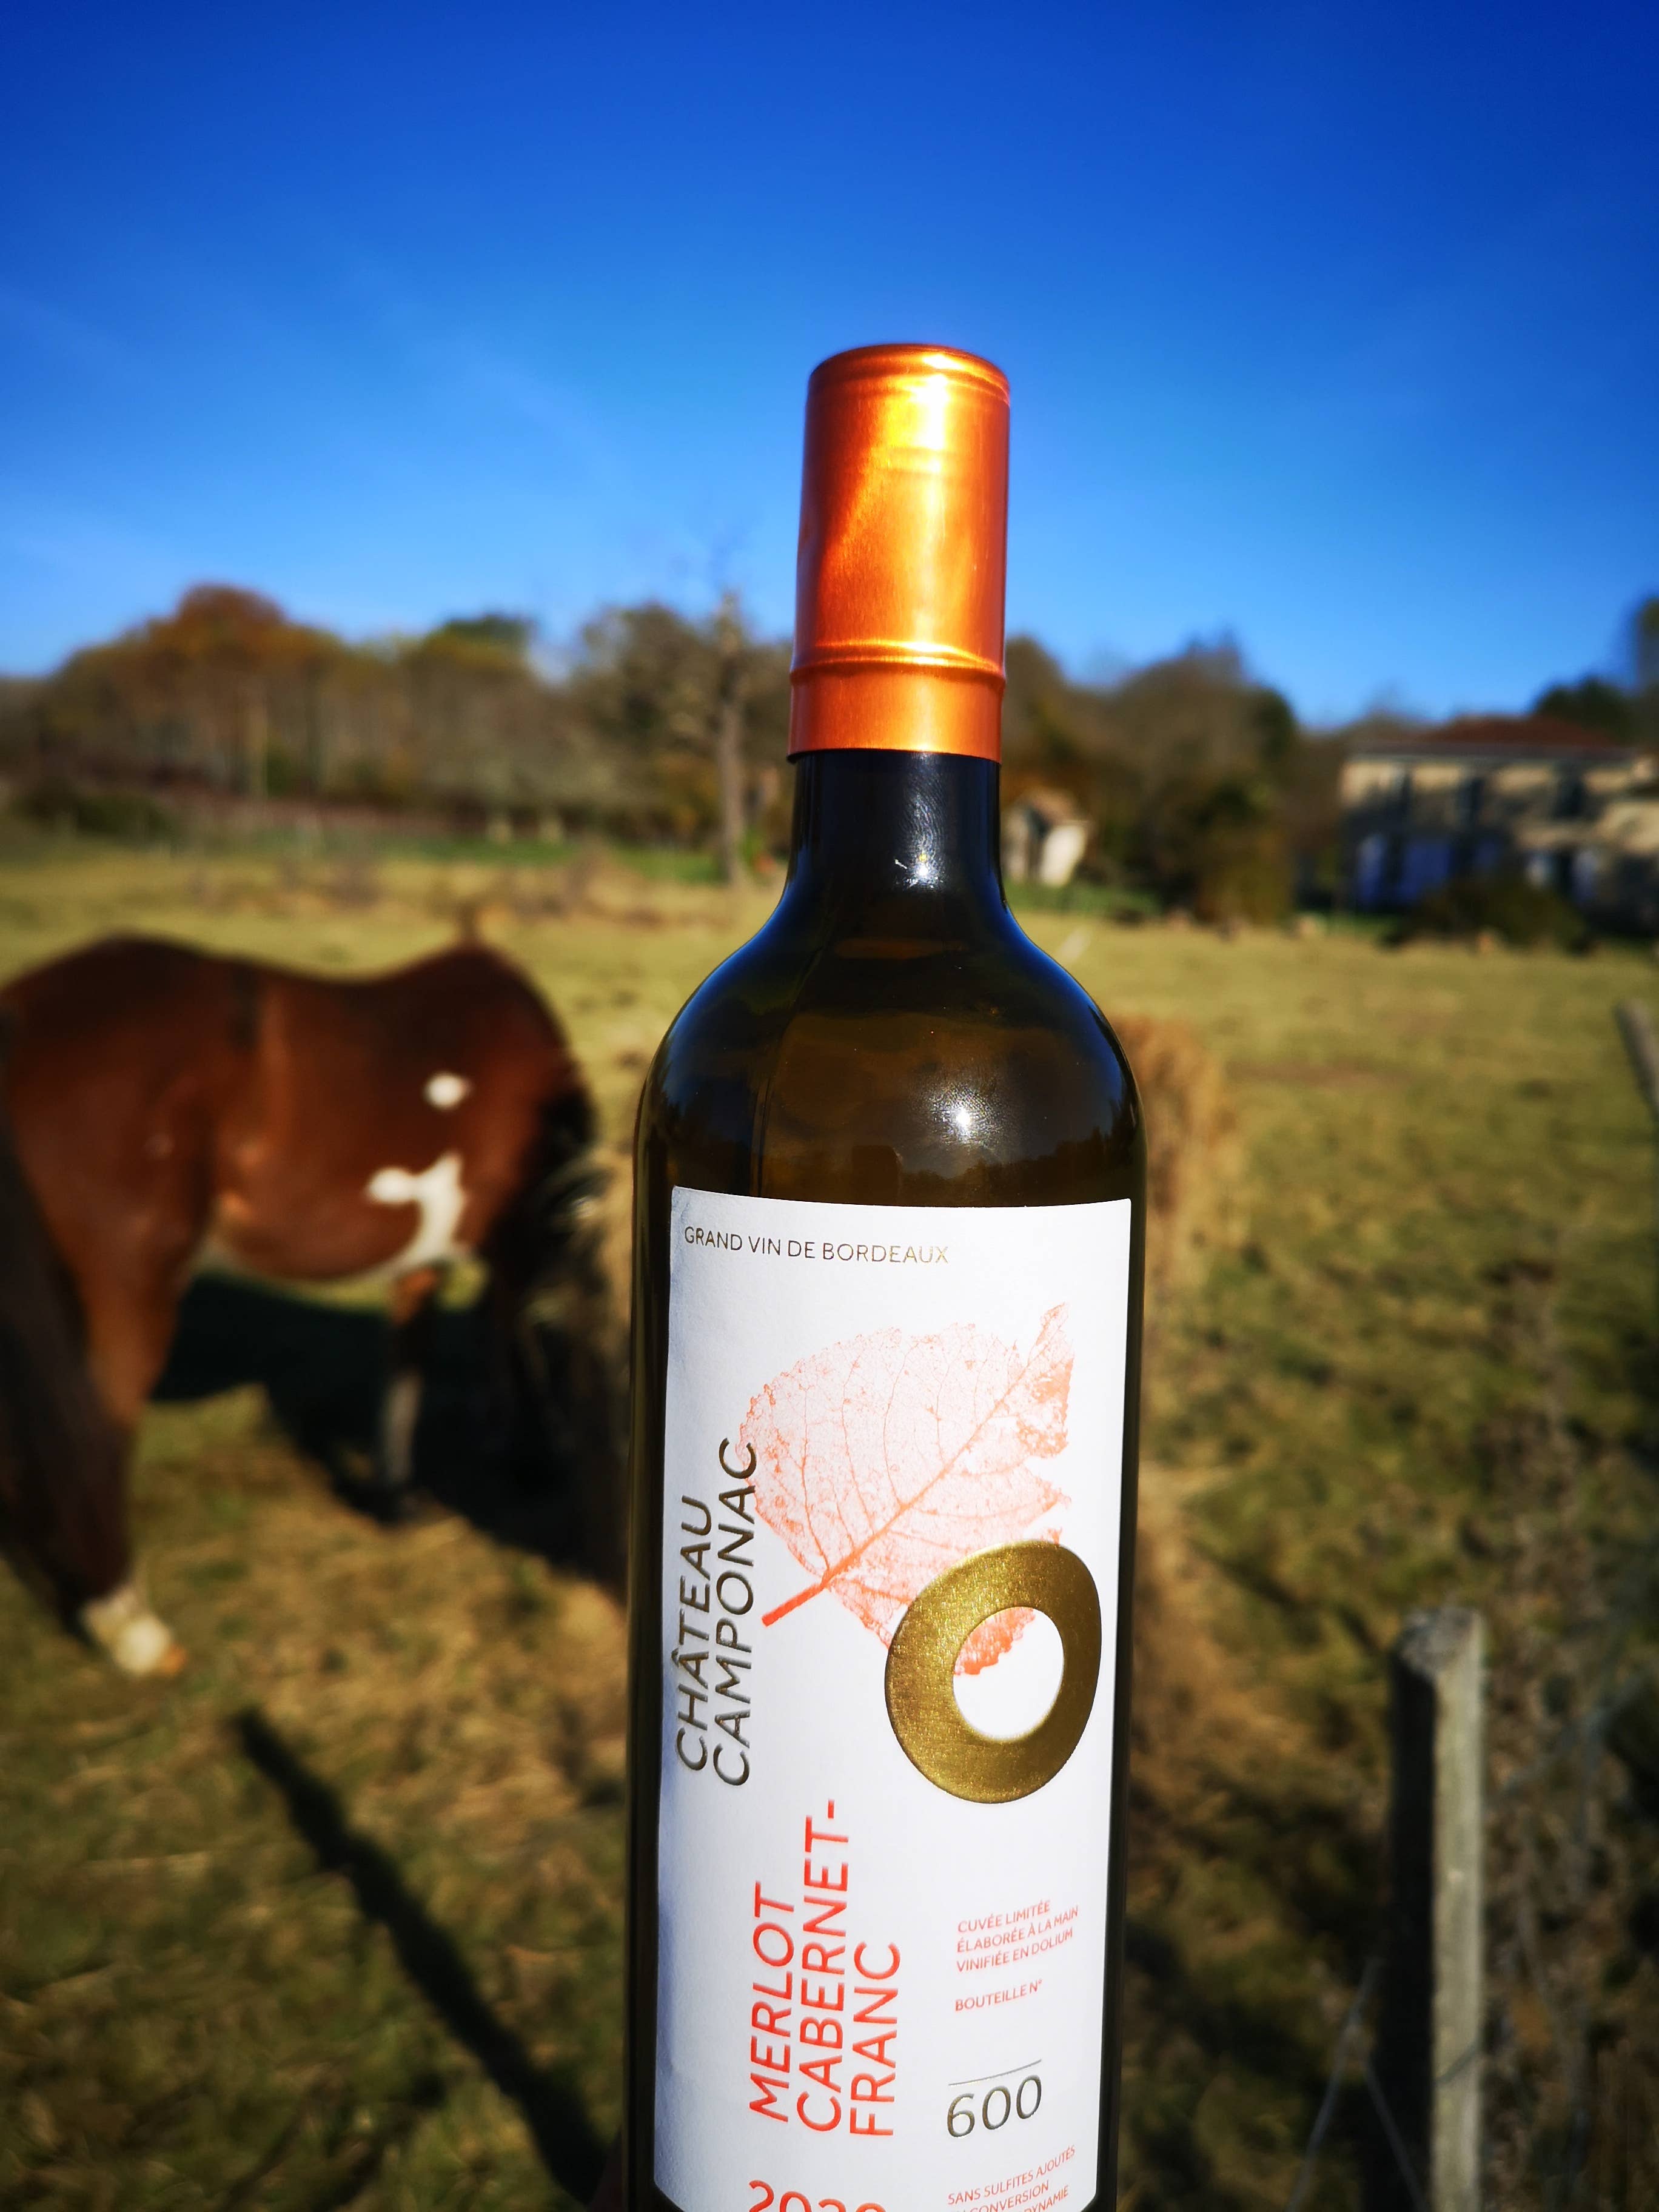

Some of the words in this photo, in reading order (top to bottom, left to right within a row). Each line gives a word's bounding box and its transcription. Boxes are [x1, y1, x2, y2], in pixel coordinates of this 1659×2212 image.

[684, 1226, 743, 1251] GRAND
[748, 1236, 782, 1256] VIN
[788, 1240, 816, 1259] DE
[823, 1242, 949, 1264] BORDEAUX
[671, 1495, 712, 1771] CHÂTEAU
[713, 1437, 757, 1786] CAMPONAC
[957, 1914, 1002, 1933] CUVÉE
[1005, 1900, 1050, 1925] LIMITÉE
[957, 1927, 1025, 1953] ÉLABORÉE
[1027, 1923, 1036, 1937] À
[1037, 1919, 1052, 1934] LA
[1054, 1905, 1079, 1926] MAIN
[797, 1799, 850, 2132] CABERNET-
[956, 1950, 1010, 1972] VINIFIÉE
[1013, 1946, 1029, 1961] EN
[1031, 1927, 1073, 1956] DOLIUM
[749, 1880, 795, 2122] MERLOT
[954, 1984, 1027, 2012] BOUTEILLE
[850, 1940, 901, 2136] FRANC
[947, 2074, 1042, 2137] 600
[948, 2188, 980, 2205] SANS
[984, 2170, 1034, 2198] SULFITES
[1036, 2144, 1076, 2179] AJOUTÉS
